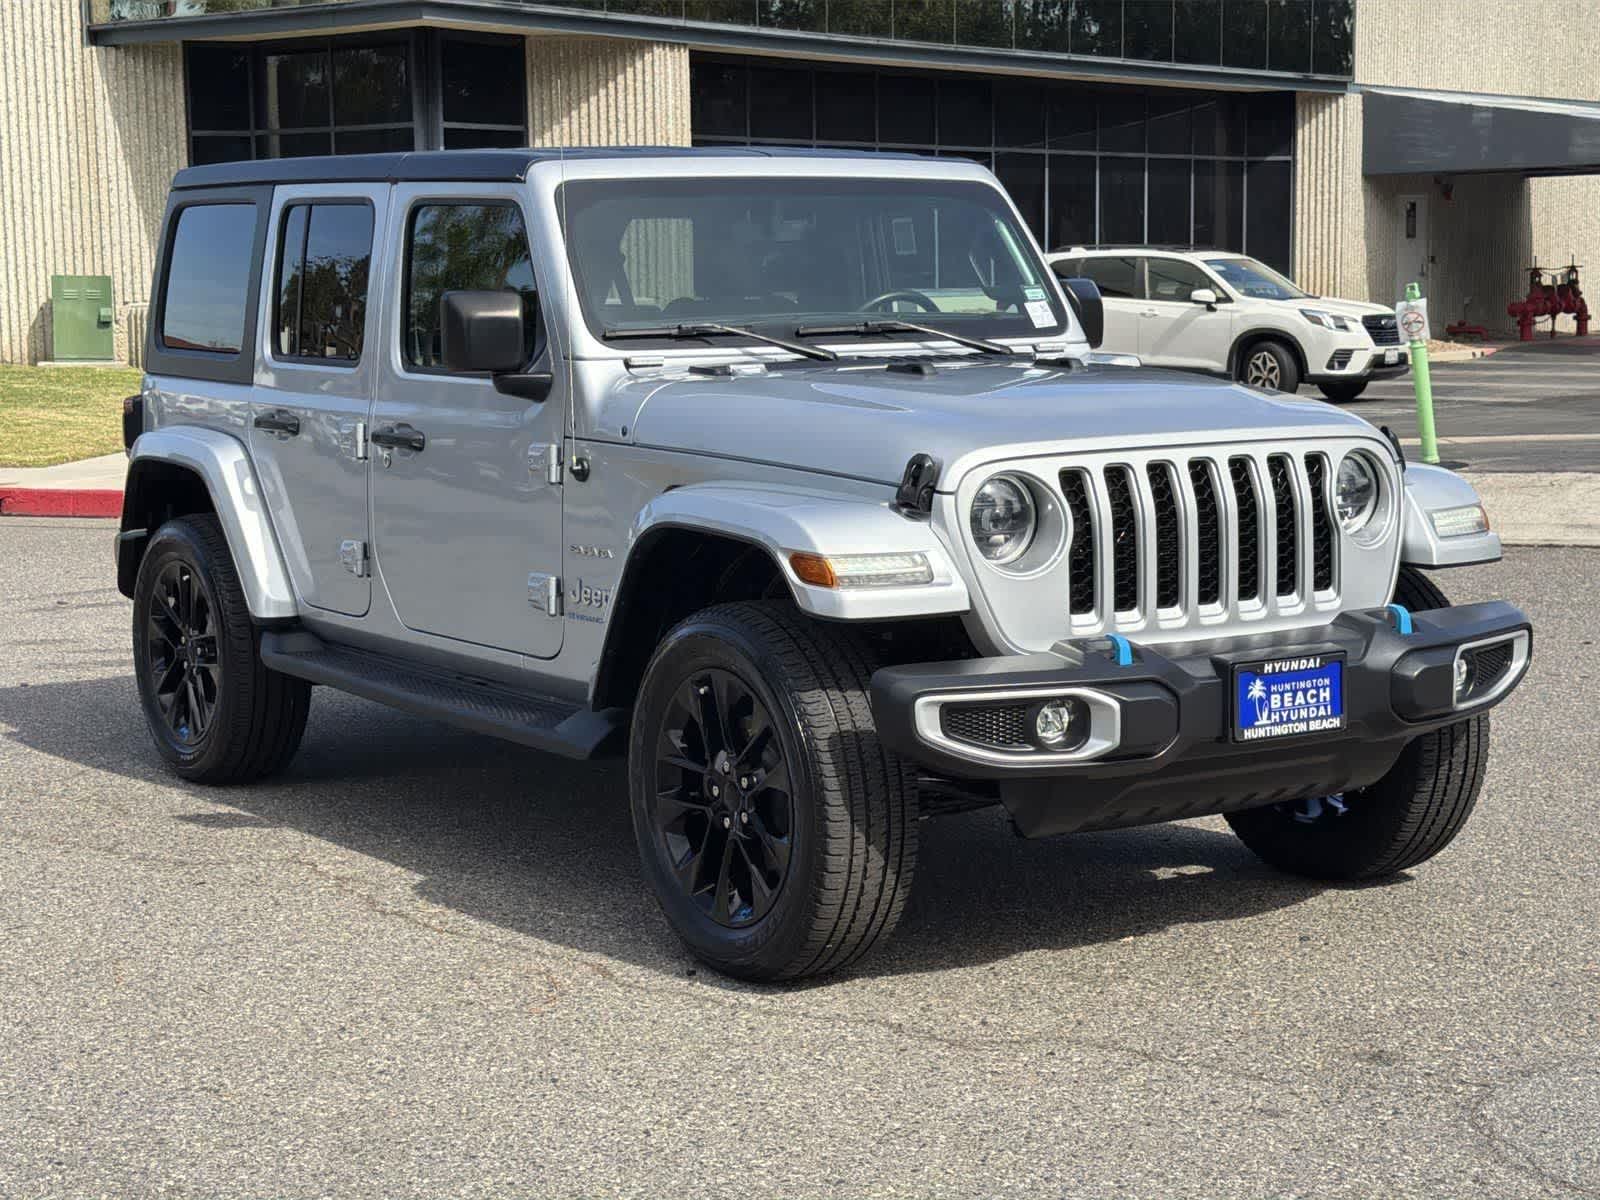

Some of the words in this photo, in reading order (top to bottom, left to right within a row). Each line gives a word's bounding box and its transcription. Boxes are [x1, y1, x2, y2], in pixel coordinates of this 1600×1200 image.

[1264, 657, 1321, 674] HYUNDAI
[1270, 677, 1330, 693] HUNTINGTON
[1270, 687, 1330, 709] BEACH
[1271, 705, 1331, 723] HYUNDAI
[1244, 721, 1307, 740] HUNTINGTON
[1309, 717, 1340, 731] BEACH
